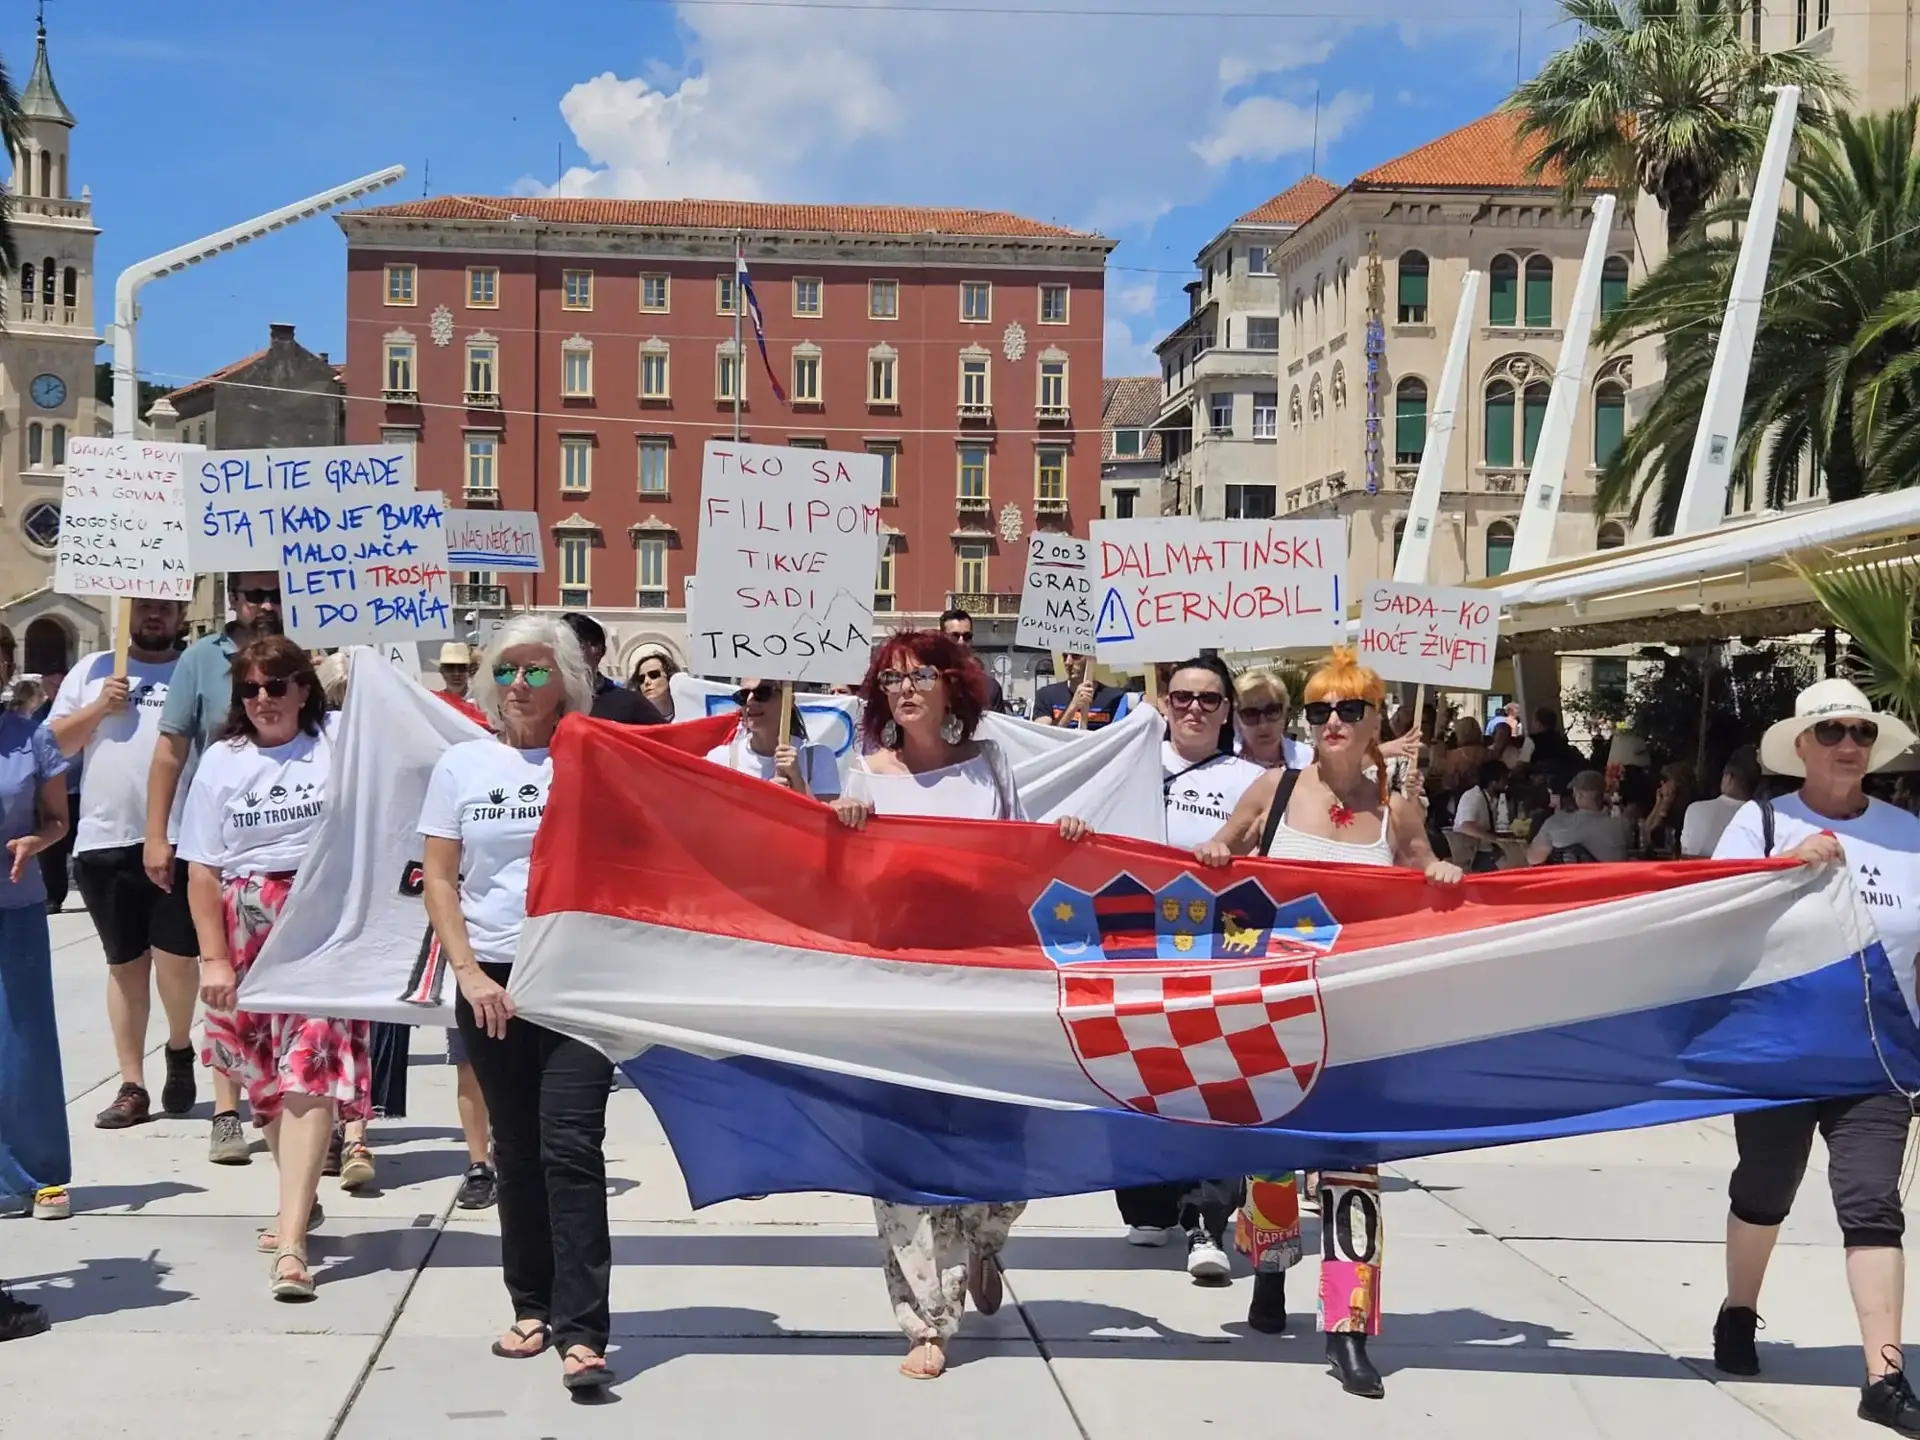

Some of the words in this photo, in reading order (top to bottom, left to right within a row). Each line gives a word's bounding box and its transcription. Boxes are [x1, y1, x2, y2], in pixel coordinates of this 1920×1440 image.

[142, 447, 182, 464] PRVI
[713, 452, 782, 476] TKO
[812, 460, 851, 483] SA
[325, 455, 403, 492] GRADE
[162, 520, 183, 531] TA
[203, 501, 252, 546] ŠTA
[282, 505, 330, 534] KAD
[337, 505, 374, 530] JE
[377, 503, 444, 531] BURA
[707, 498, 880, 535] FILIPOM
[60, 533, 117, 549] PRIČA
[140, 538, 163, 549] NE
[462, 521, 484, 551] NAS
[60, 552, 144, 570] PROLAZI
[162, 558, 185, 572] NA
[282, 543, 347, 566] MALO
[354, 535, 418, 561] JAČA
[738, 550, 827, 572] TIKVE
[1032, 540, 1044, 559] 2
[1052, 547, 1070, 559] OD
[1075, 544, 1086, 560] 3
[1100, 527, 1323, 579] DALMATINSKI
[287, 561, 356, 595] LETI
[366, 565, 447, 593] TROSKA
[1029, 572, 1091, 593] GRAD
[292, 604, 298, 628] I
[319, 603, 358, 628] DO
[367, 590, 449, 629] BRAČA
[737, 587, 814, 609] SADI
[1021, 616, 1070, 634] GRADSKI
[701, 623, 870, 658] TROSKA
[1038, 637, 1049, 646] LI
[1361, 623, 1417, 655] HOĆE
[233, 811, 260, 828] STOP
[473, 807, 505, 821] STOP
